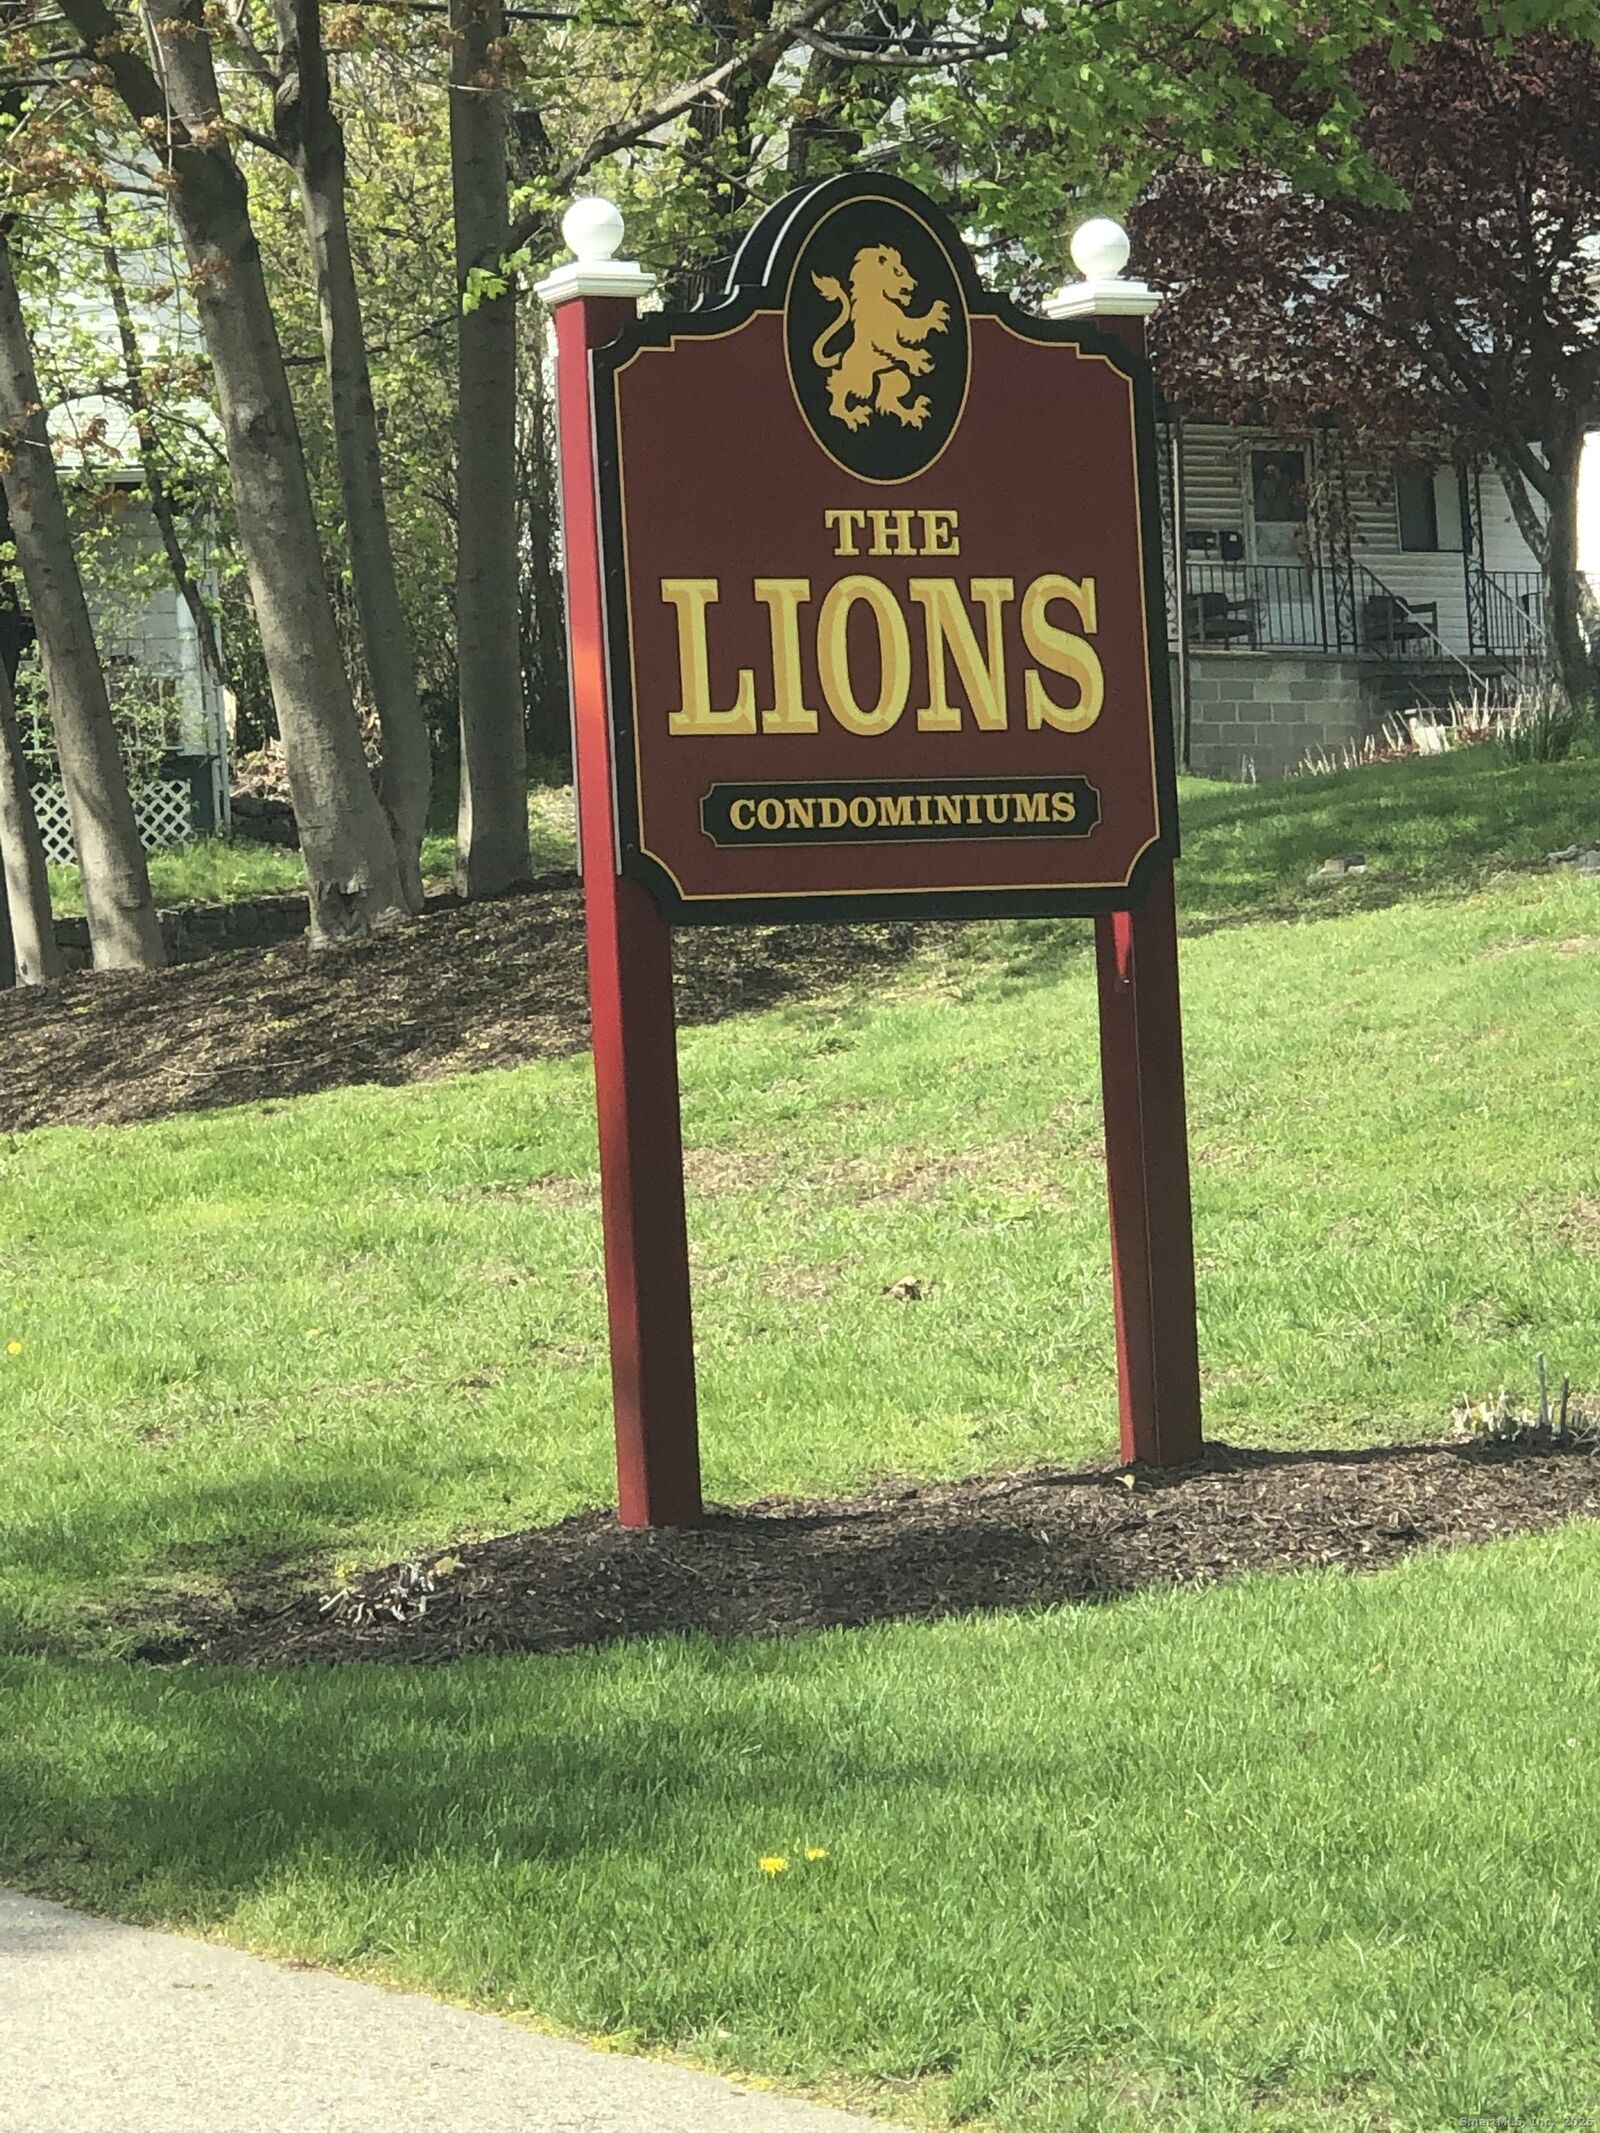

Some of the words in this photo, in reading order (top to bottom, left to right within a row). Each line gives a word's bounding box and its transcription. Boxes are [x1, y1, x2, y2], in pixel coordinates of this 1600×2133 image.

[825, 510, 960, 556] THE
[661, 574, 1104, 736] LIONS
[730, 791, 1076, 830] CONDOMINIUMS
